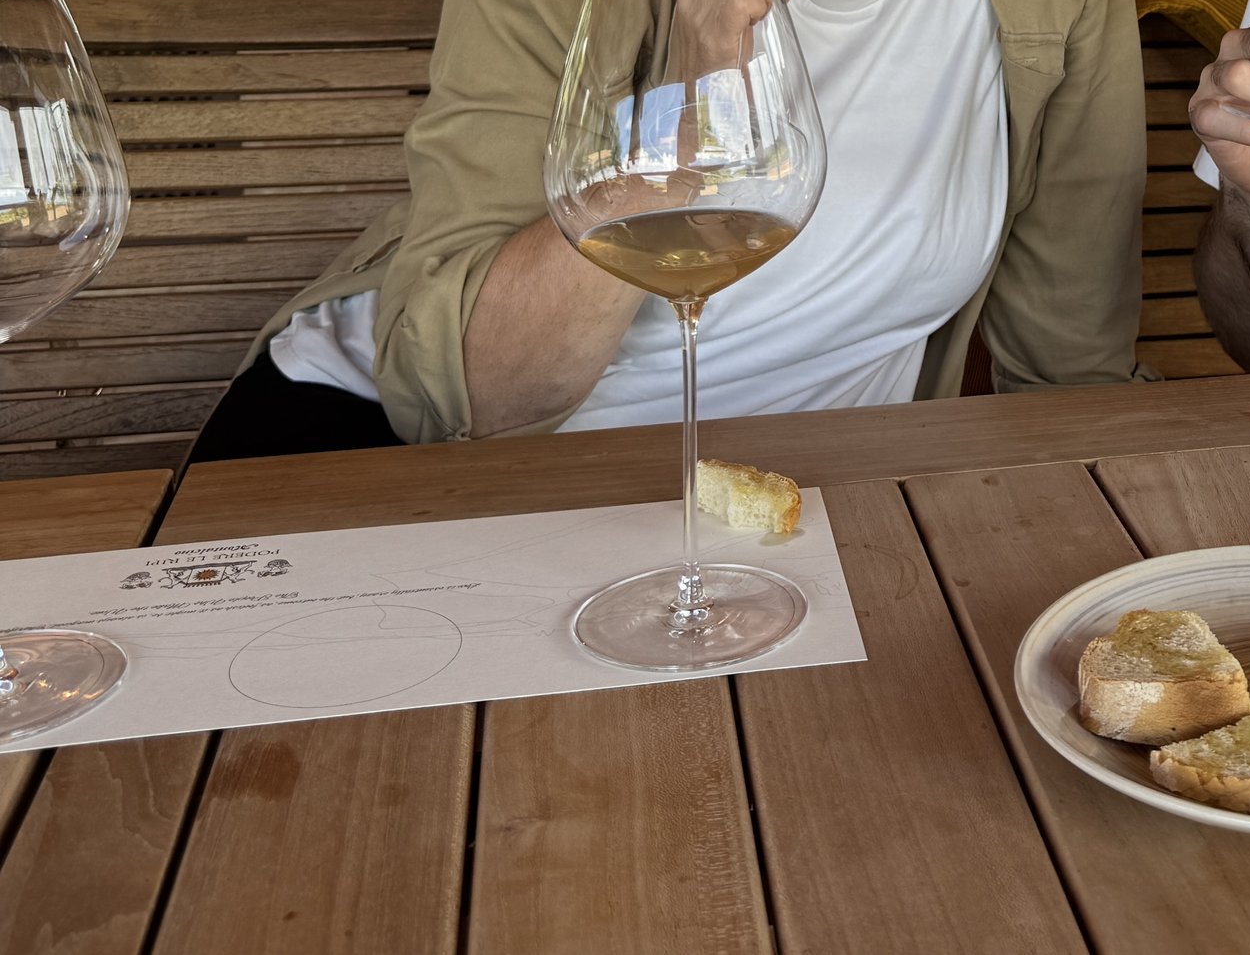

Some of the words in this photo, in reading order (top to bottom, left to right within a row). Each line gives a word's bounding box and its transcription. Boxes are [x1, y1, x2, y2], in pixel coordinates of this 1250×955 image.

[174, 543, 260, 556] Montalcino
[213, 549, 281, 561] PODERE
[145, 557, 180, 567] RIPI
[186, 555, 206, 563] LE
